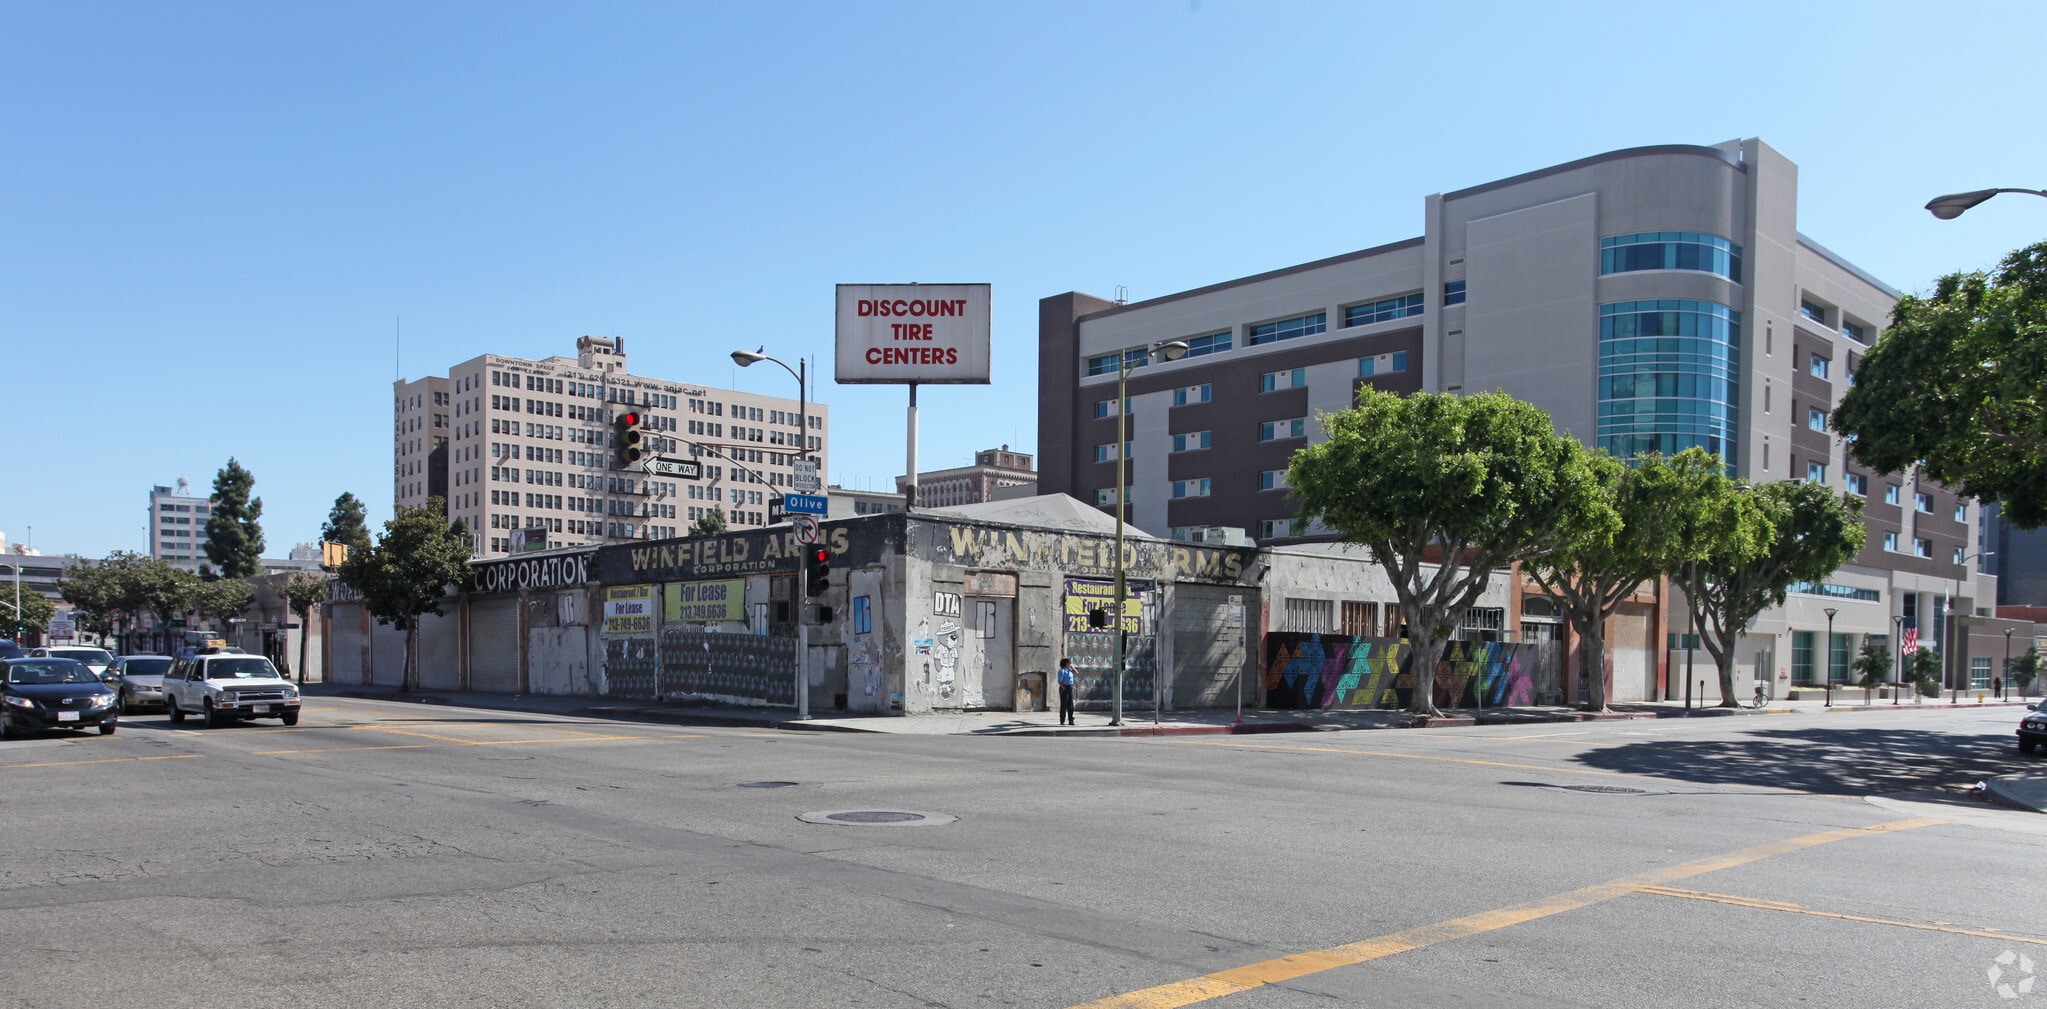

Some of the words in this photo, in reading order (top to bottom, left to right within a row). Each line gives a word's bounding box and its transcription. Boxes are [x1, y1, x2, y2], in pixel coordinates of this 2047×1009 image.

[858, 299, 967, 317] DISCOUNT
[891, 323, 933, 341] TIRE
[865, 347, 958, 365] CENTERS
[495, 357, 533, 368] DOWNTOWN
[535, 362, 555, 371] SPACE
[507, 365, 520, 373] FOR
[656, 461, 673, 473] ONE
[678, 464, 696, 475] WAY
[795, 464, 802, 472] DO
[805, 465, 815, 473] NOT
[795, 474, 815, 483] BLOCK
[790, 497, 823, 509] Olive
[631, 537, 750, 571] WINFIELD
[763, 527, 850, 560] ARS
[474, 555, 588, 591] CORPORATION
[693, 559, 776, 575] CORPORATION
[610, 587, 636, 599] Restaurant
[640, 586, 649, 598] Bar
[680, 583, 696, 602] For
[697, 583, 727, 601] Lease
[615, 602, 625, 614] For
[625, 602, 643, 614] Lease
[935, 592, 960, 614] DTA
[1083, 599, 1097, 613] For
[680, 603, 727, 620] 213.749.6636
[609, 616, 651, 631] 213-749-6636
